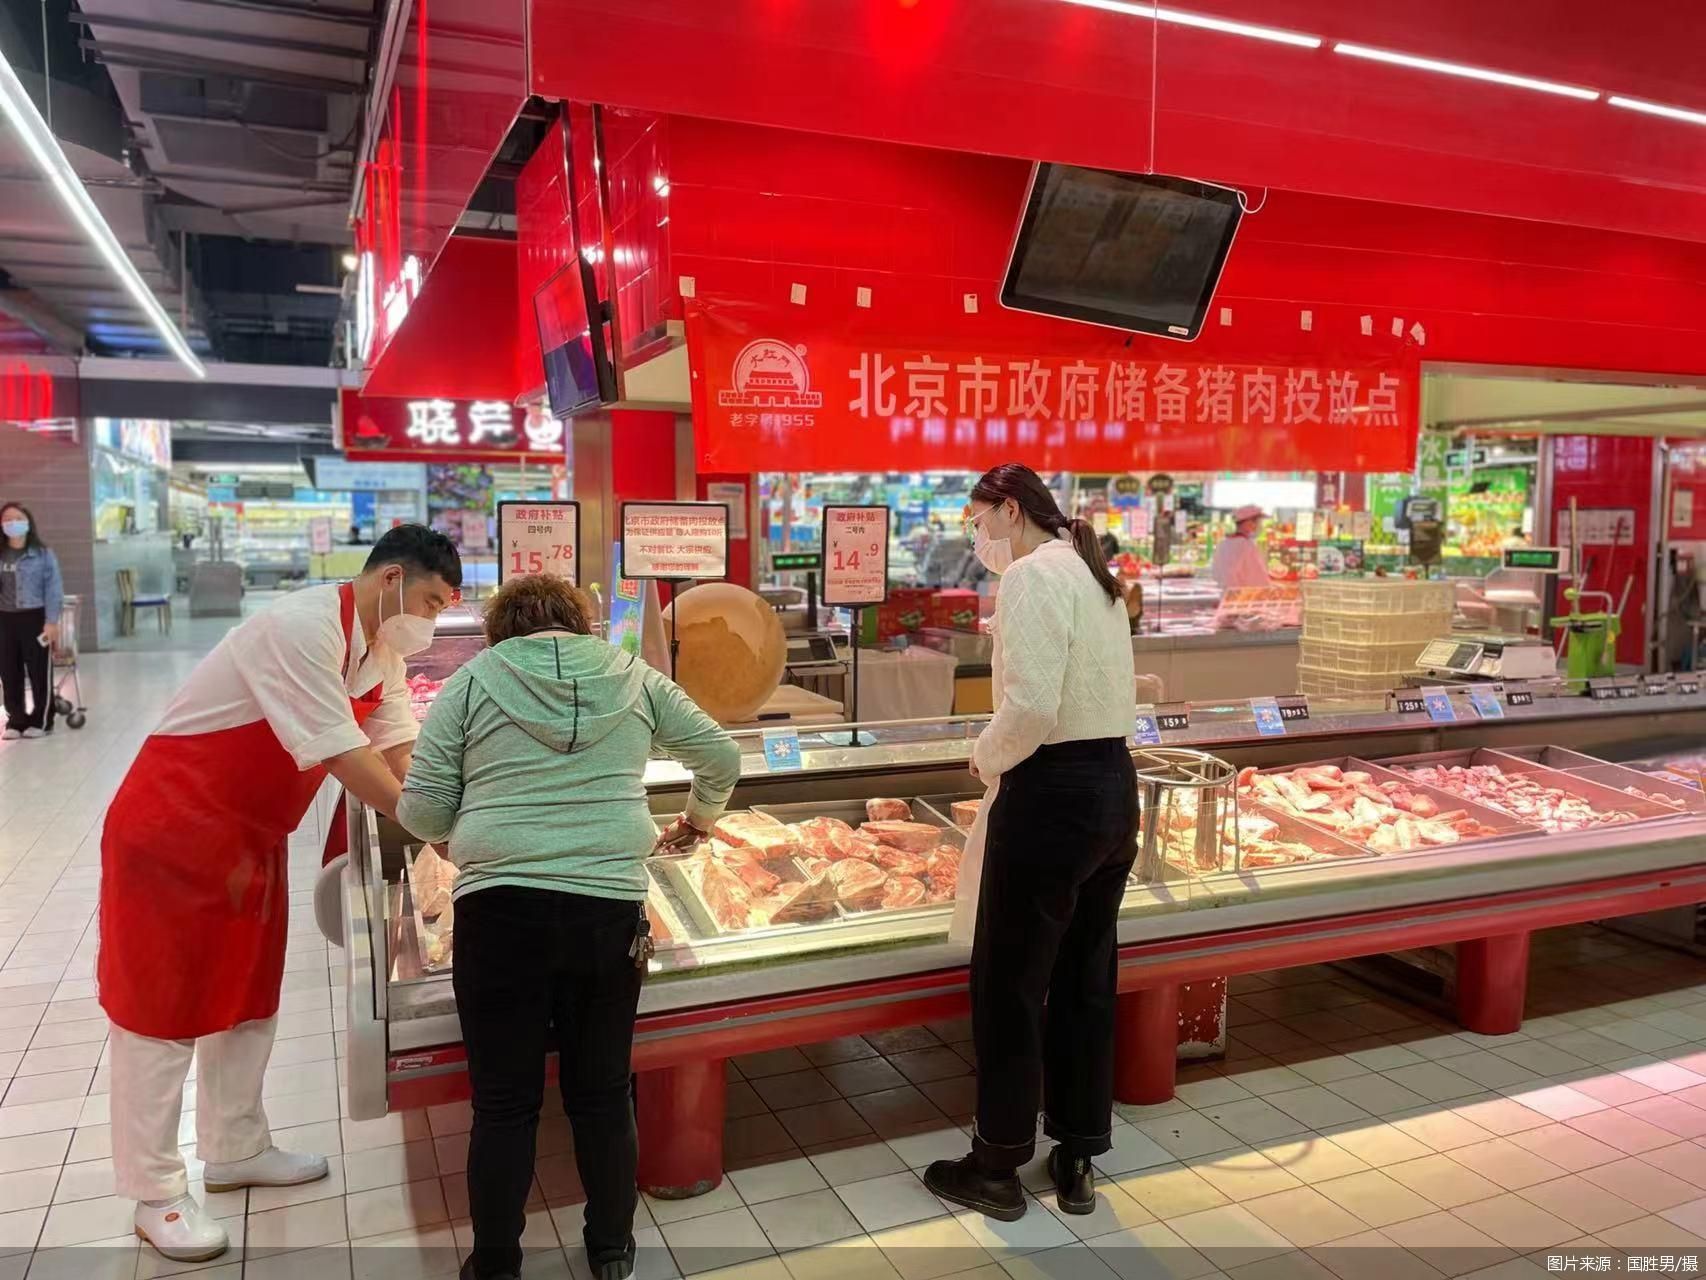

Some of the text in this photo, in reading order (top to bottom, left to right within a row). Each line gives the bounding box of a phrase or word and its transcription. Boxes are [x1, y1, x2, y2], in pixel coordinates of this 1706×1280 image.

[848, 352, 1401, 427] 北京市政府储备猪肉投放点
[514, 508, 564, 520] 政府补贴
